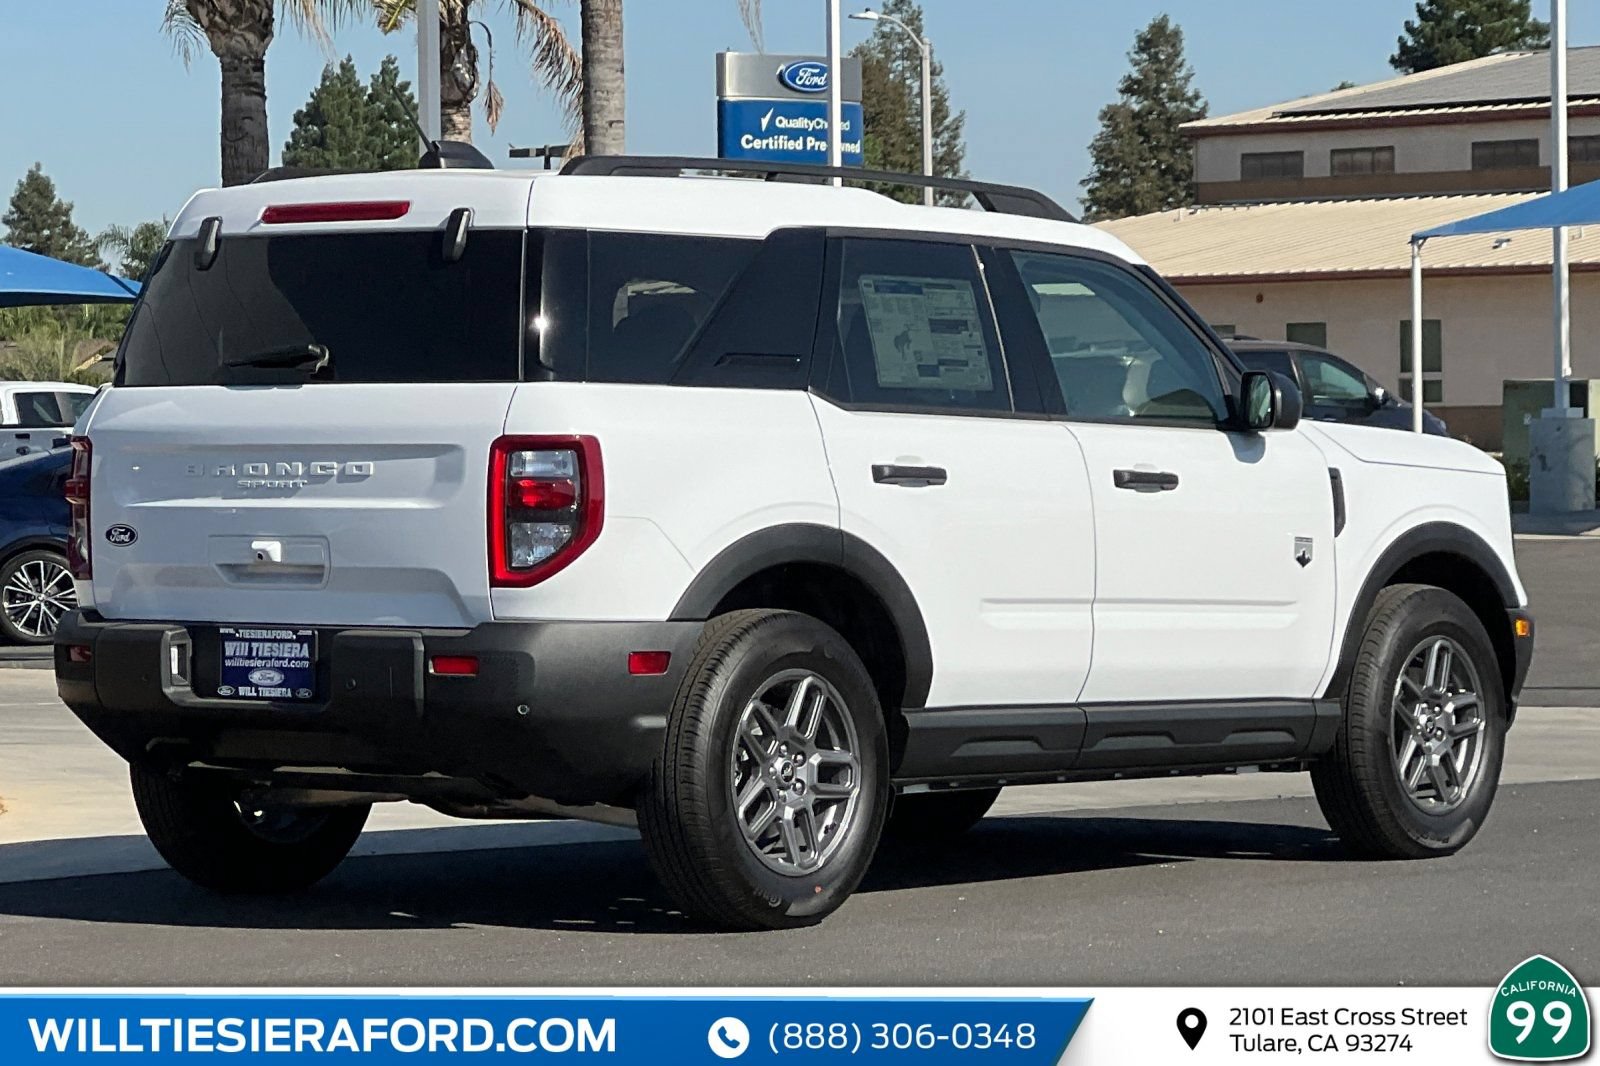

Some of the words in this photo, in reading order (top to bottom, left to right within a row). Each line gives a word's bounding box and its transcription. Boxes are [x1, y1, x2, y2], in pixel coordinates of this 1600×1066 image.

[796, 67, 827, 85] Ford
[775, 116, 850, 131] QualityChed
[740, 134, 803, 151] Certified
[184, 461, 374, 477] BRONCO
[237, 479, 308, 489] SPORT
[250, 642, 310, 659] TIESIERA
[224, 657, 310, 669] willtiesieraford.com
[238, 686, 257, 697] WILL
[258, 687, 293, 698] TIESIERA
